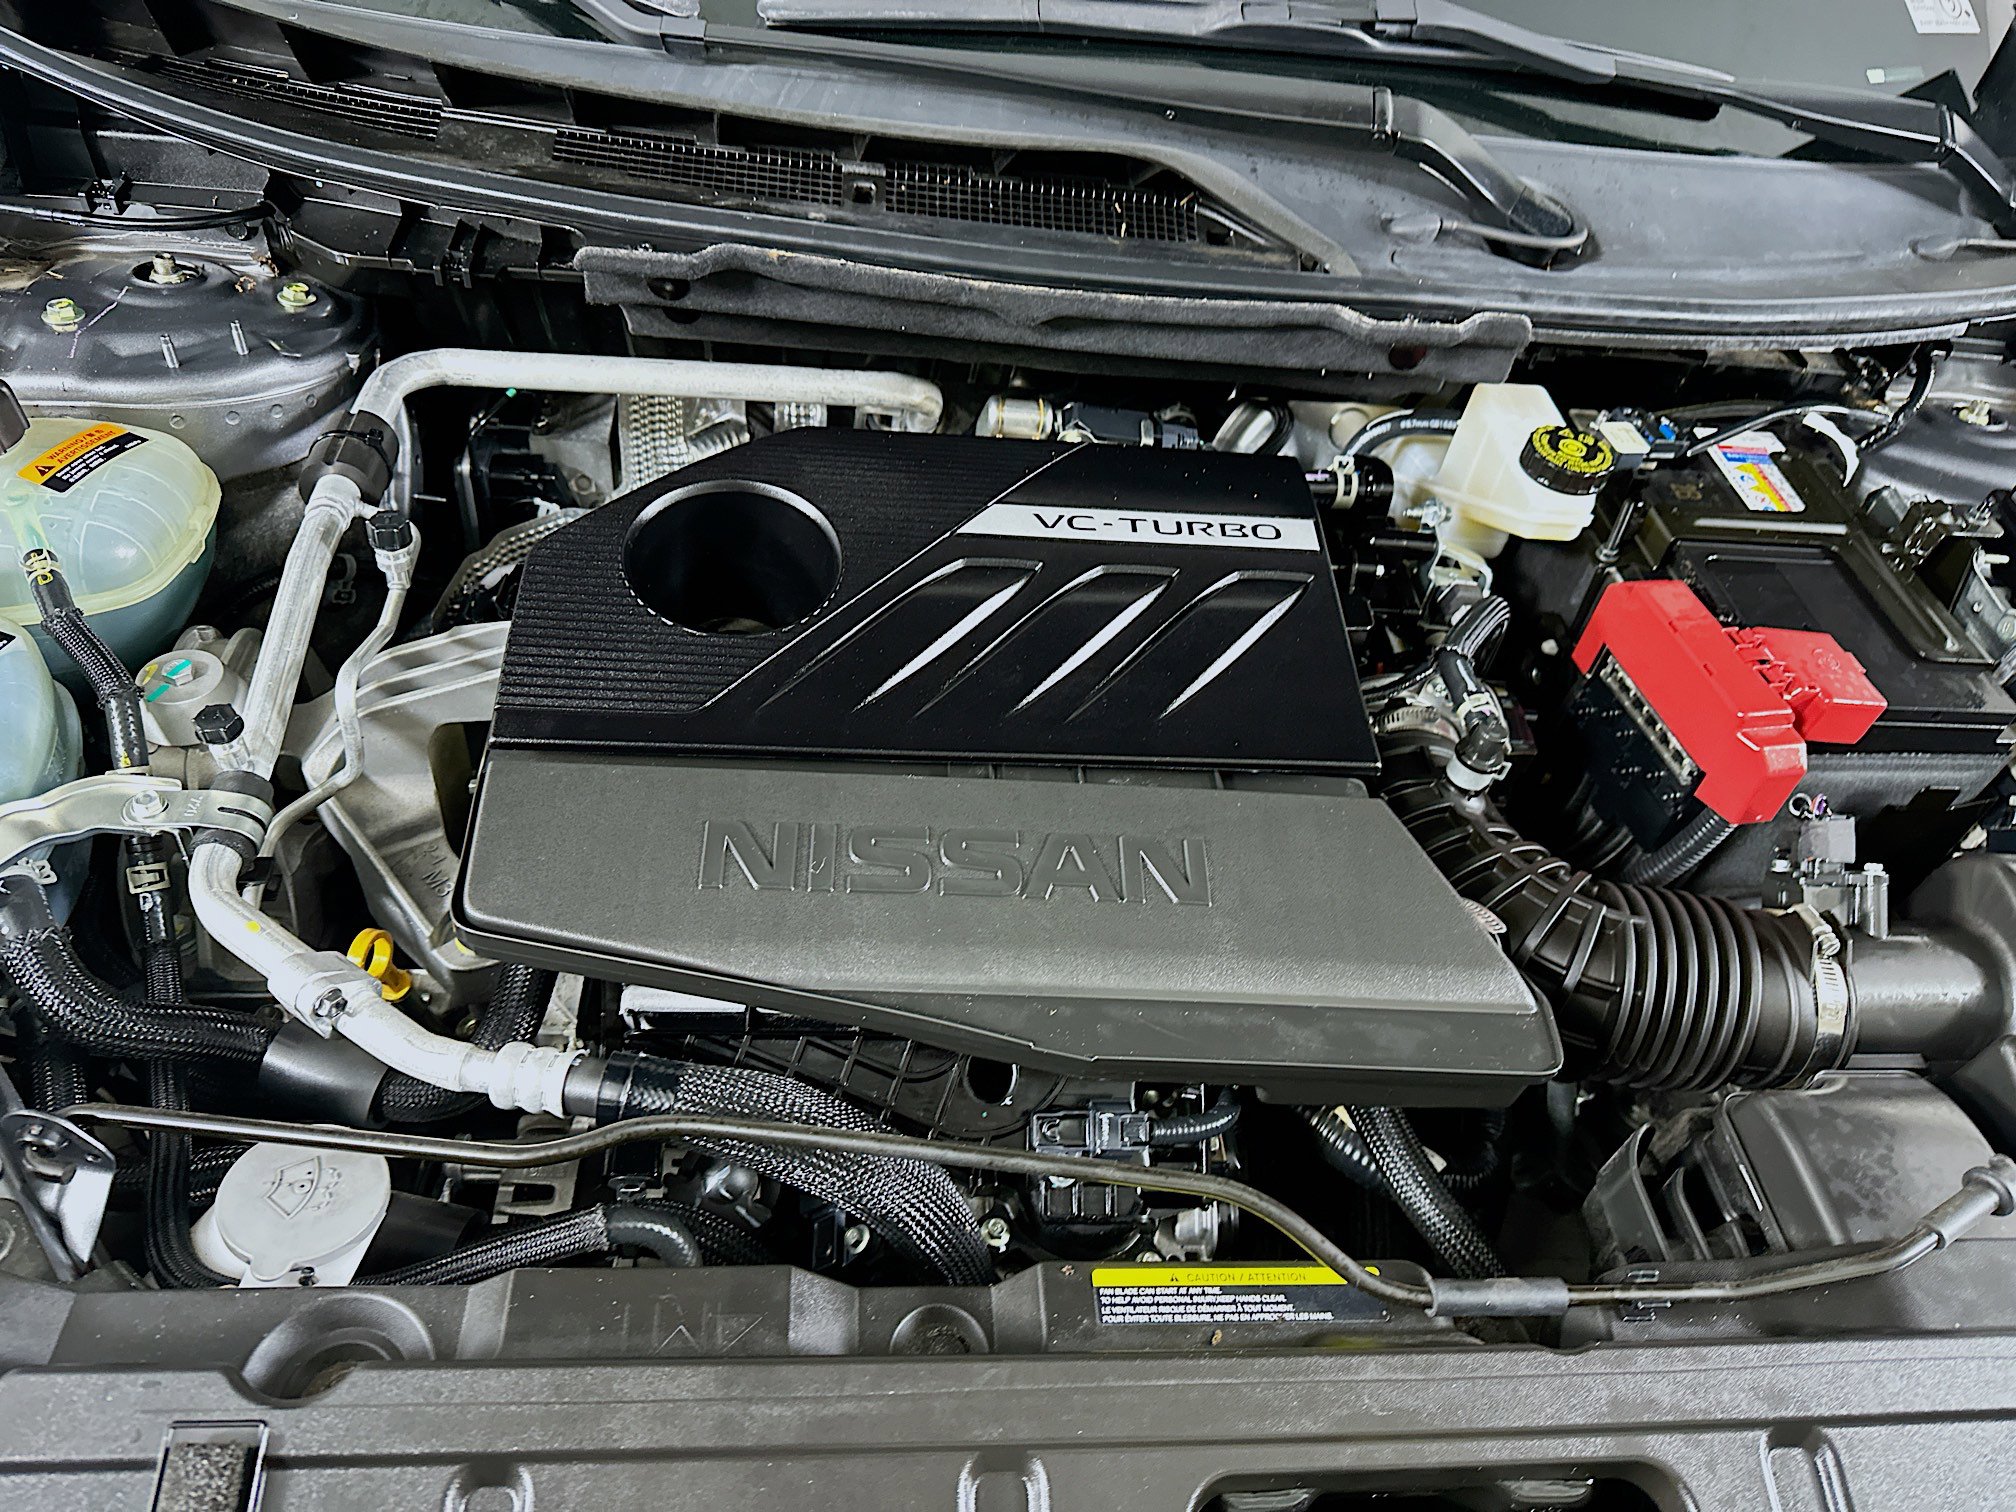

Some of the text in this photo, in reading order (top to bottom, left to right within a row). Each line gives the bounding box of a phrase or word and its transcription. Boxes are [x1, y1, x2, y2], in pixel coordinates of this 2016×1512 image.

[47, 437, 84, 461] WARNING
[57, 430, 118, 464] AVERTISSEMENT
[1033, 513, 1282, 540] VC-TURBO
[699, 820, 1213, 906] NISSAN
[1186, 1273, 1236, 1283] CAUTION
[1248, 1272, 1307, 1282] ATTENTION
[1100, 1296, 1111, 1305] TO
[1112, 1296, 1131, 1304] HELP
[1131, 1296, 1153, 1304] AVOID
[1101, 1306, 1111, 1314] LE
[1186, 1305, 1196, 1313] DE
